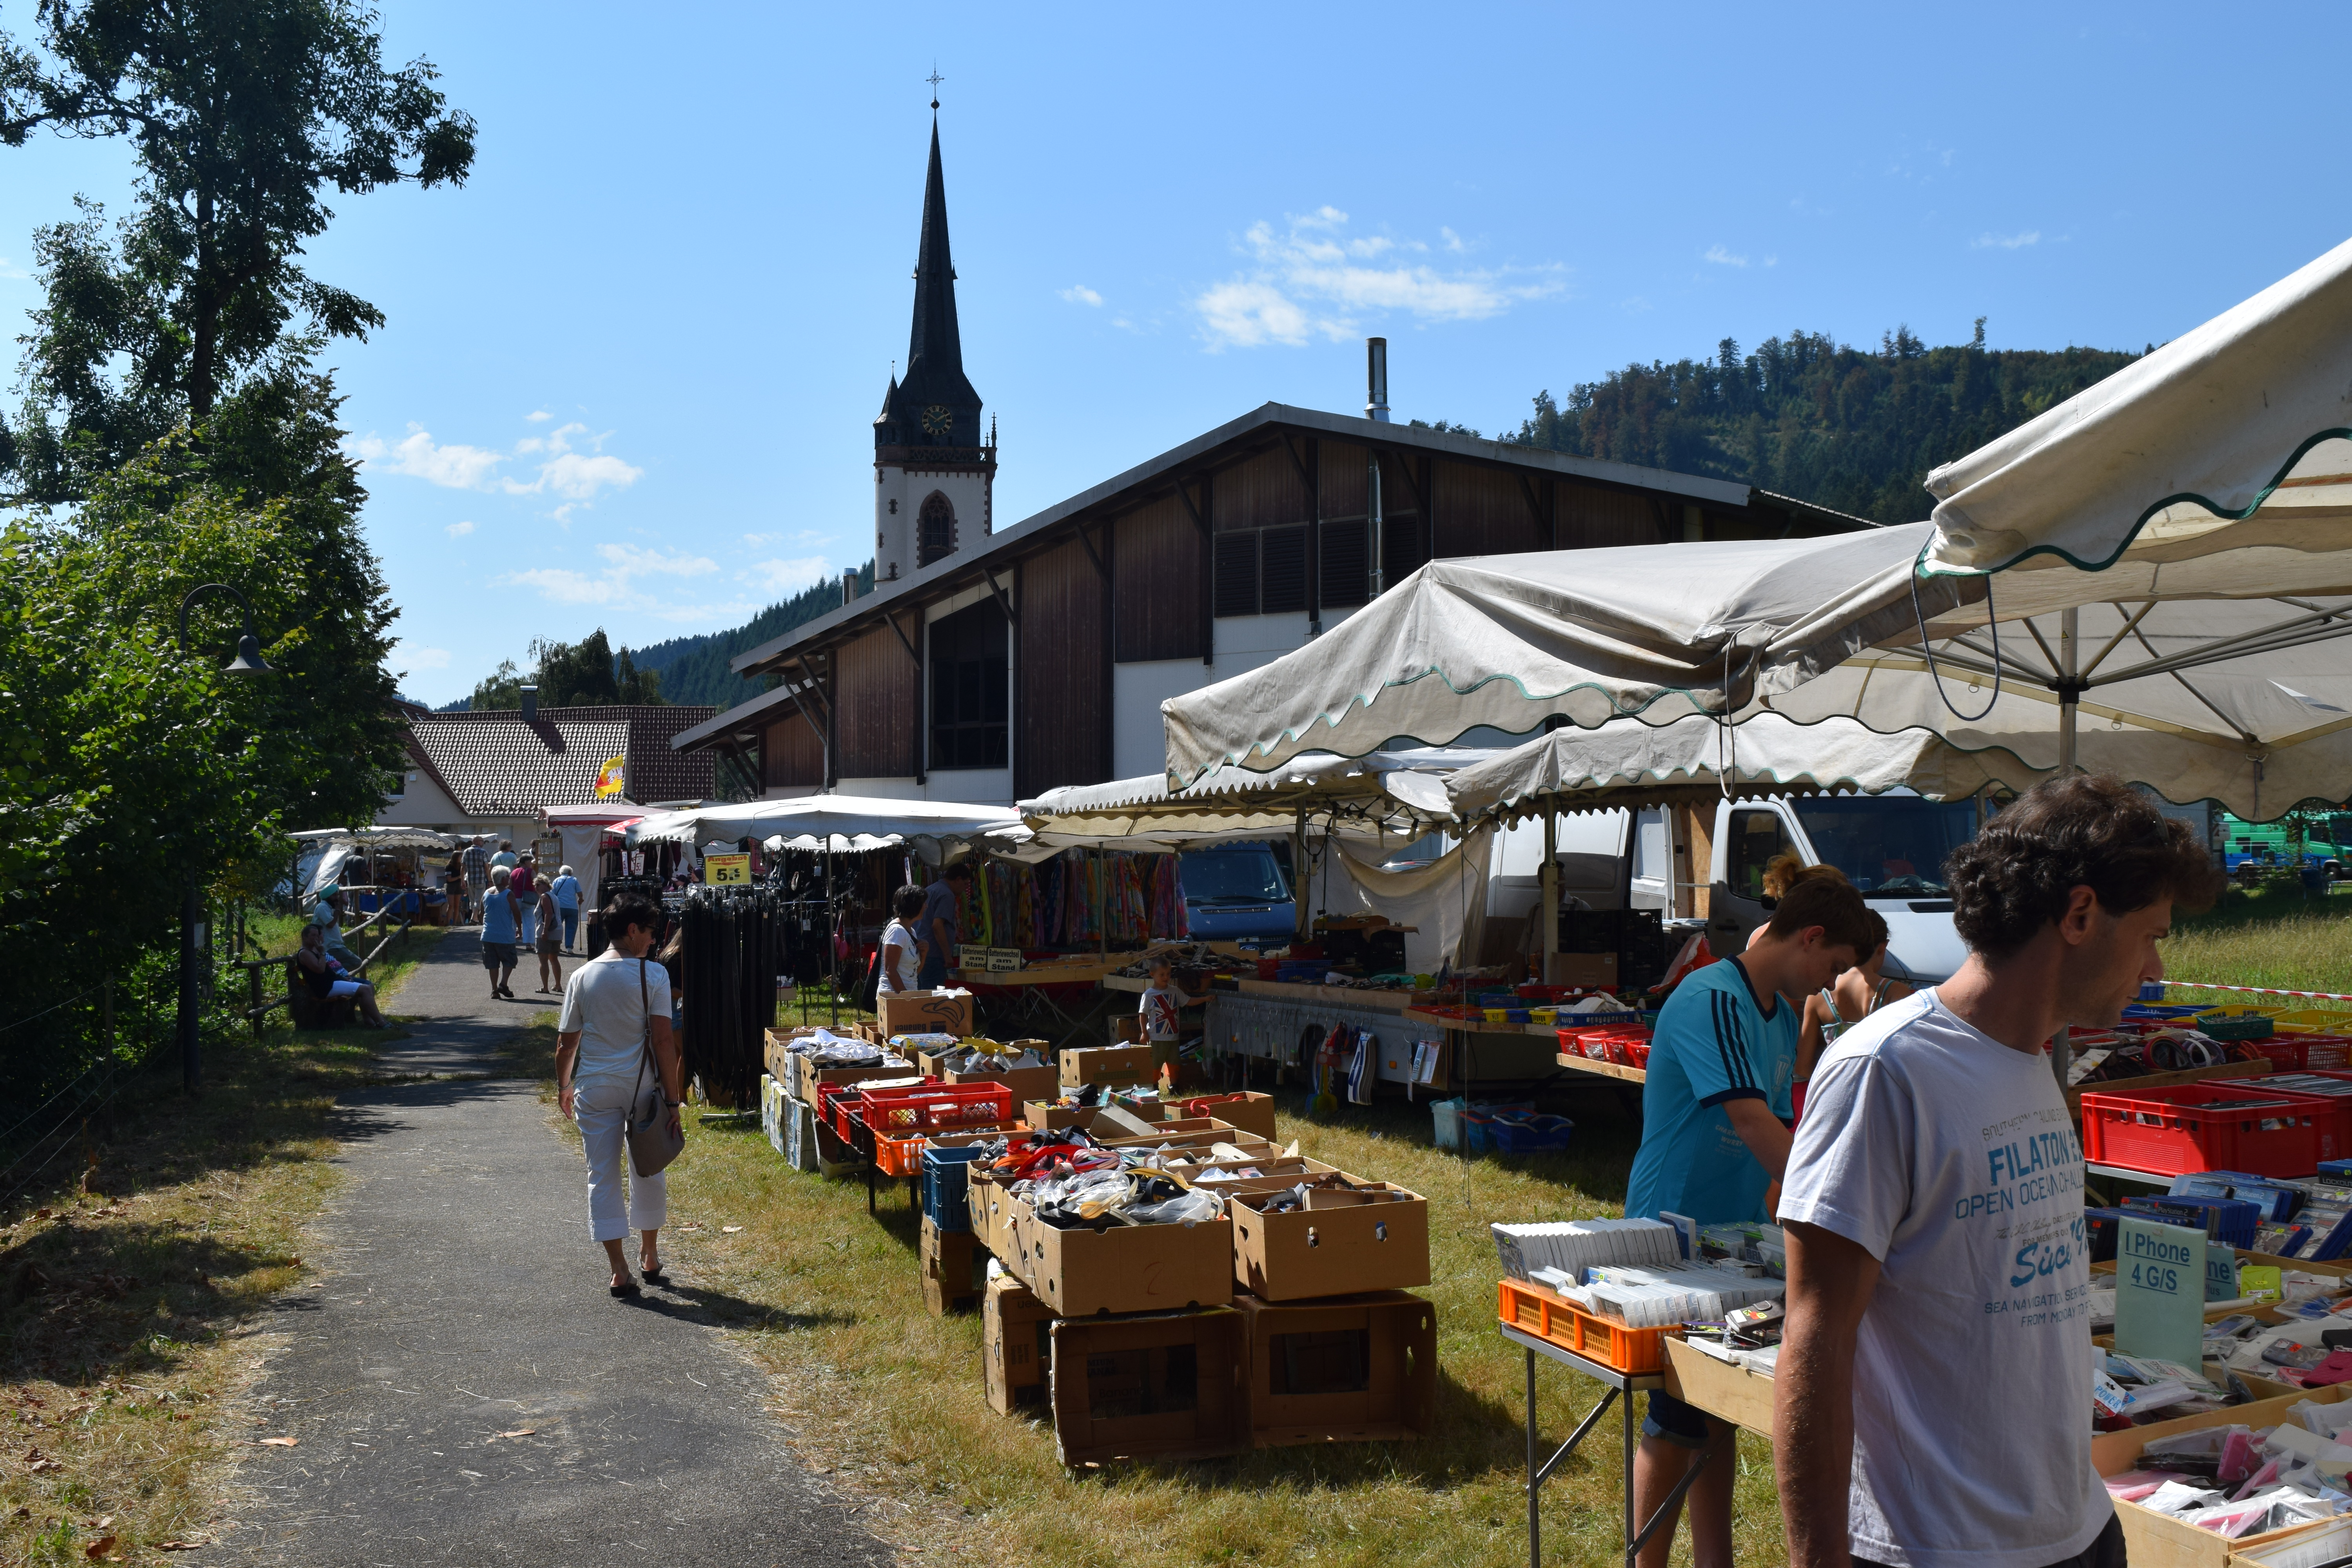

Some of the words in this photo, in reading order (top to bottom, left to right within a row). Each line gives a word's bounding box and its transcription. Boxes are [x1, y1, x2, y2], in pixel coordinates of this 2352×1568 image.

[989, 949, 1019, 958] Batteriewechsel
[895, 1024, 926, 1032] Bananen
[1988, 1131, 2070, 1186] FILATON
[2236, 1189, 2260, 1199] PlayStation
[1956, 1189, 2014, 1220] OPEN
[2158, 1207, 2183, 1215] PlayStation
[2036, 1230, 2059, 1244] MEMRS
[2135, 1232, 2190, 1263] Phone
[1144, 1261, 1164, 1296] 2
[2131, 1263, 2141, 1283] 4
[2146, 1265, 2177, 1291] G/S
[2207, 1260, 2230, 1280] ne
[1985, 1301, 2007, 1314] SEA
[2021, 1312, 2046, 1327] FROM
[2094, 1385, 2122, 1408] POWER
